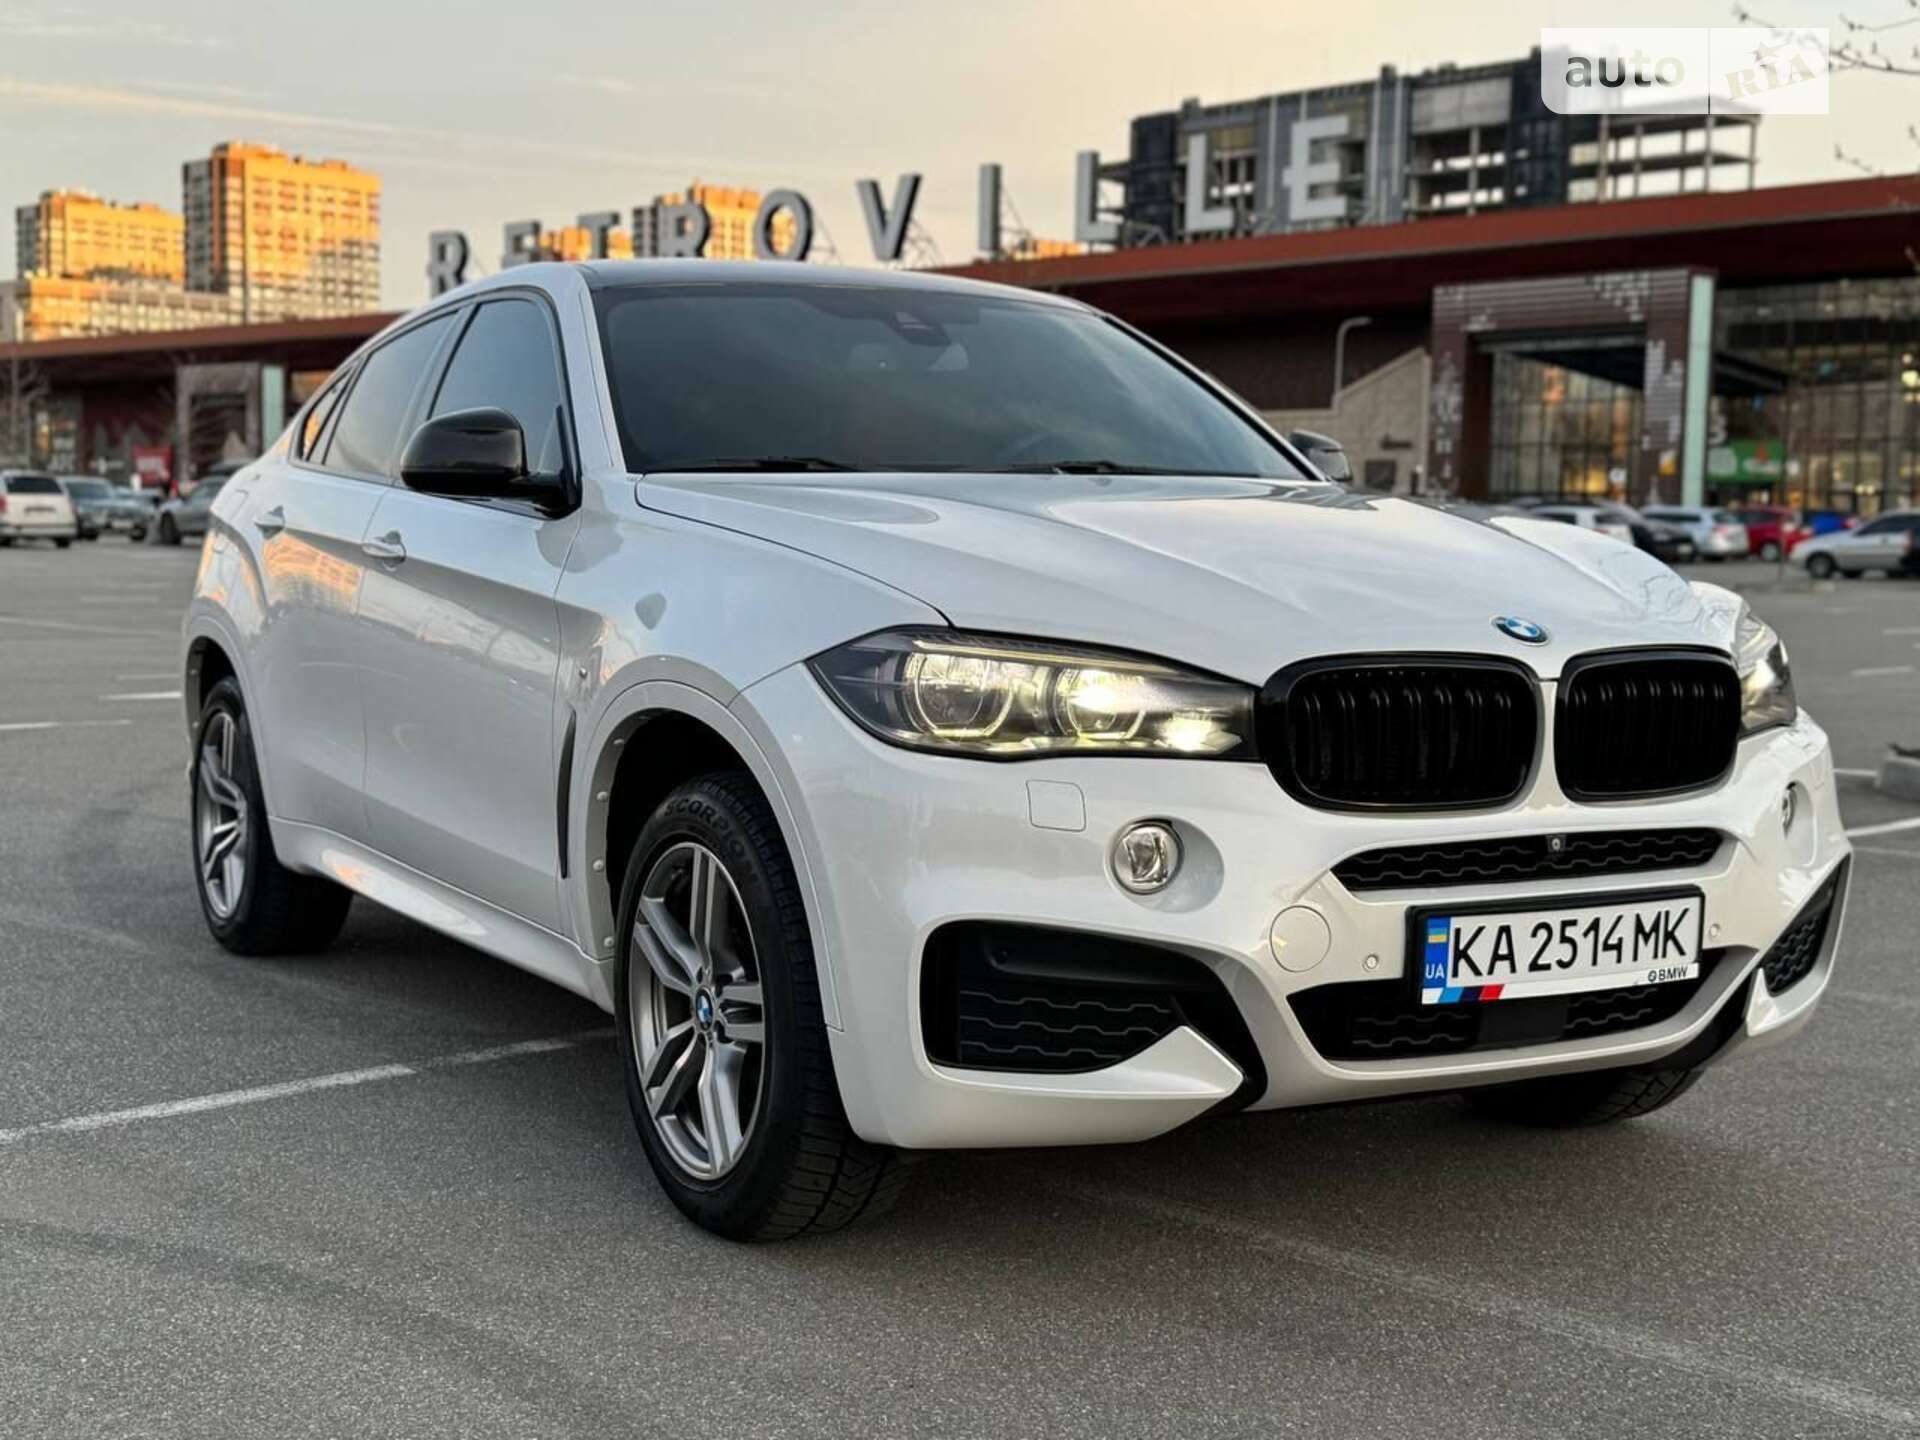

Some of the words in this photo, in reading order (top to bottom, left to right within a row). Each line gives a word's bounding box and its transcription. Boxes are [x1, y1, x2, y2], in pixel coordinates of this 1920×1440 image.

[428, 115, 1350, 300] RETROVILLE
[1452, 924, 1517, 978] KA
[1528, 914, 1624, 972] 2514
[1632, 907, 1690, 962] MK
[1425, 963, 1445, 979] UA
[1658, 966, 1688, 980] BMW
